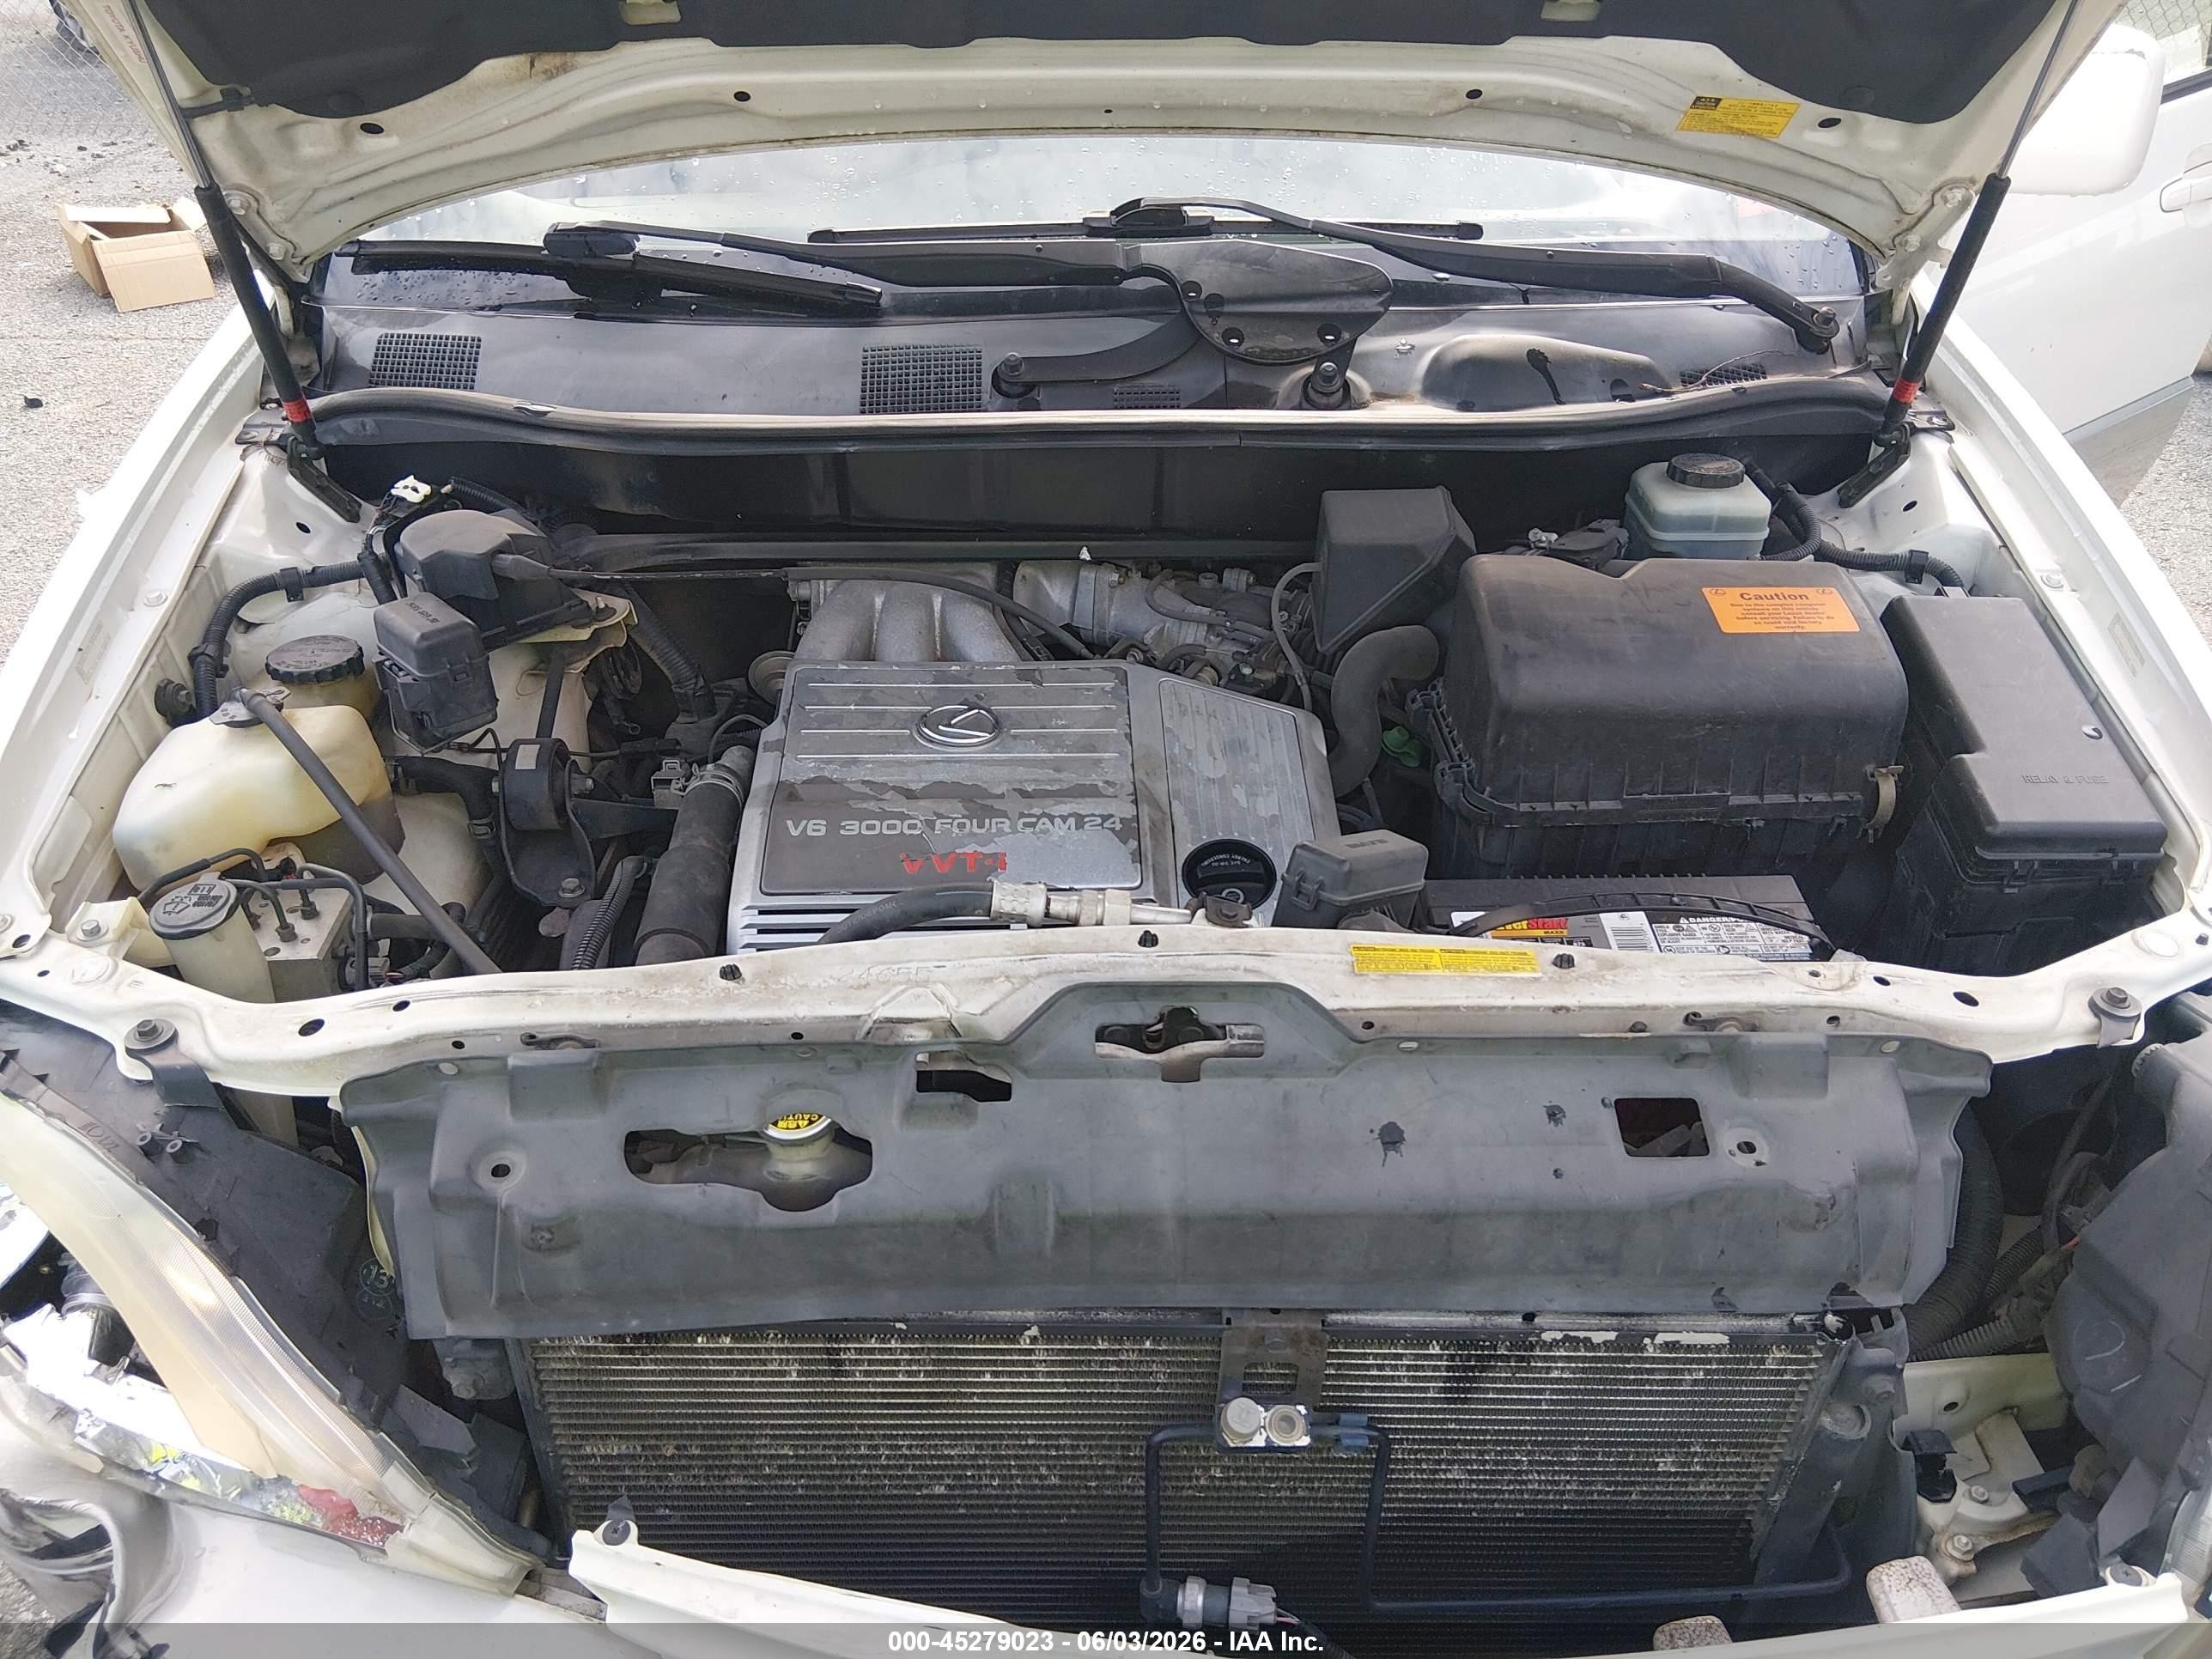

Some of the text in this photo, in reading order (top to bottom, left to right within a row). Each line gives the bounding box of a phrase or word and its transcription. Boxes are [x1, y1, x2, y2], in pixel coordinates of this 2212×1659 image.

[1740, 592, 1809, 601] Caution
[2021, 775, 2059, 784] RELAY
[2075, 775, 2109, 784] FUSE
[786, 816, 1123, 837] V6 3000 FOUR CAM 24
